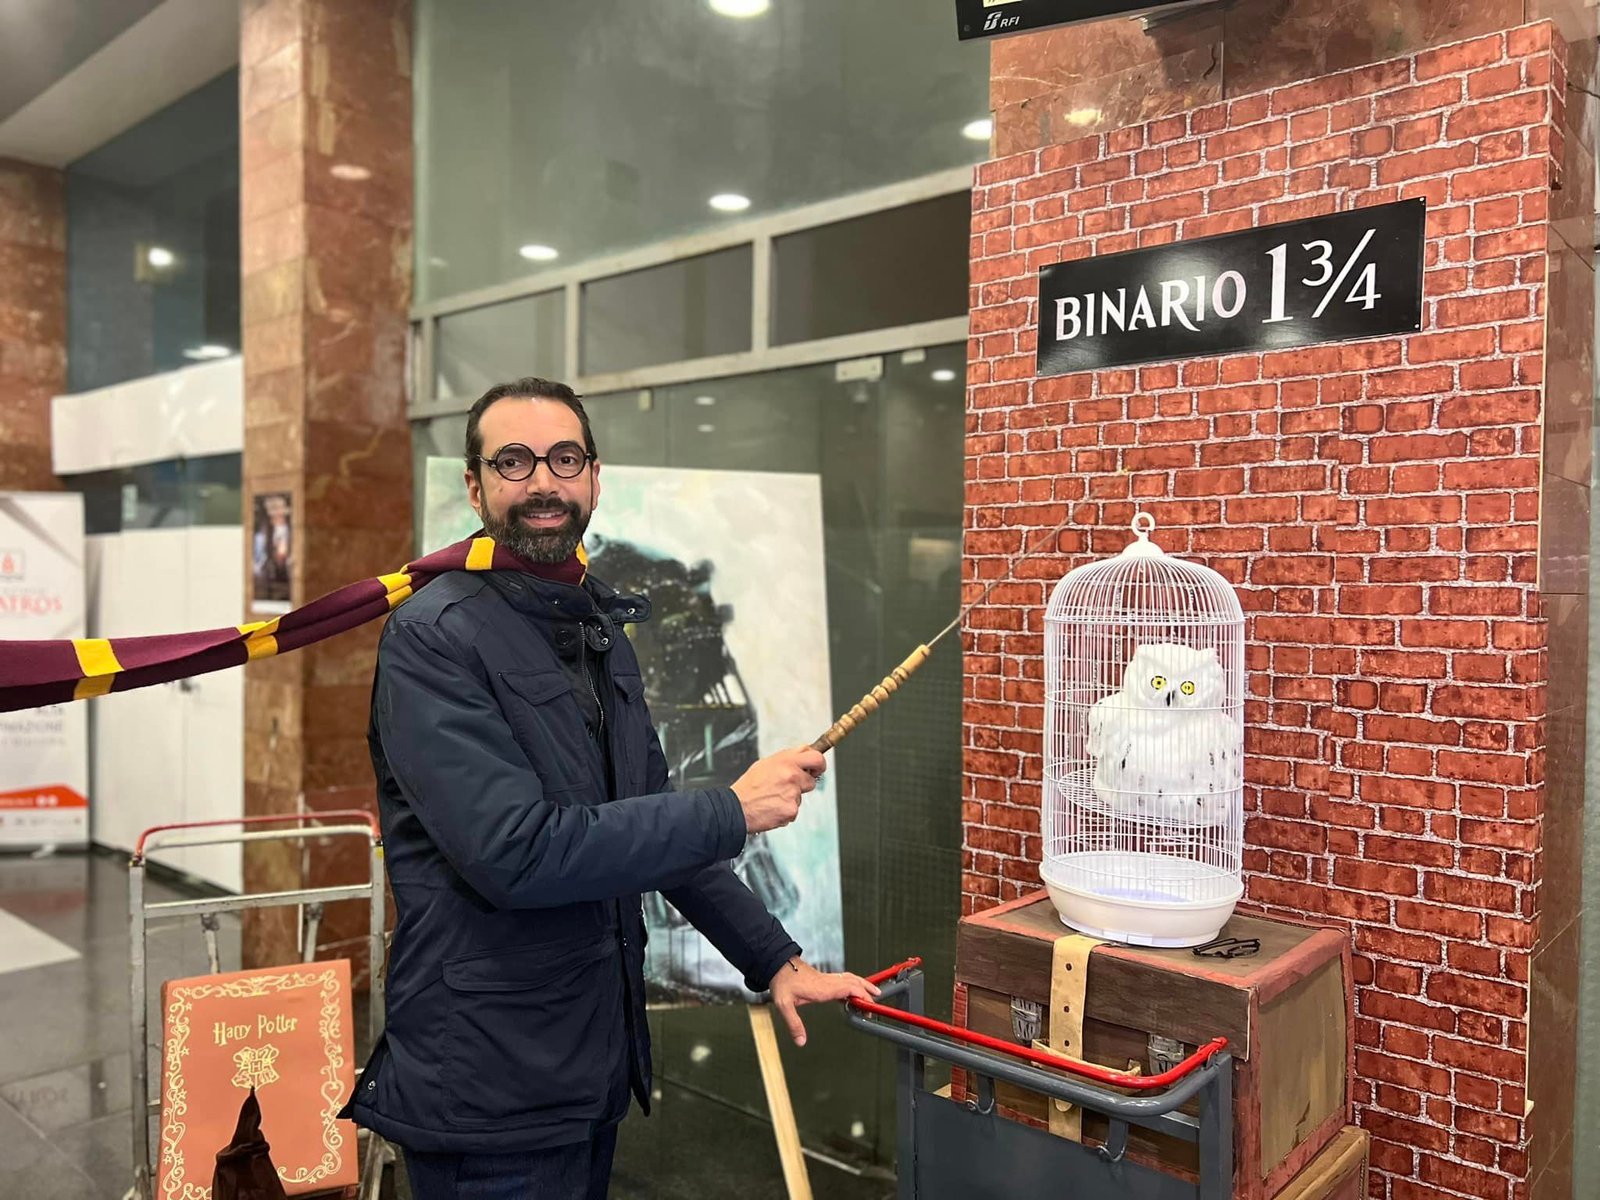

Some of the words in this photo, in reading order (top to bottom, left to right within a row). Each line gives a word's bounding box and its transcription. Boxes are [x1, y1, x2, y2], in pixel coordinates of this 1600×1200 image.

[1000, 16, 1020, 28] RFI
[1054, 270, 1247, 342] BINARIO
[212, 1022, 252, 1047] Harry
[257, 1014, 298, 1039] Potter
